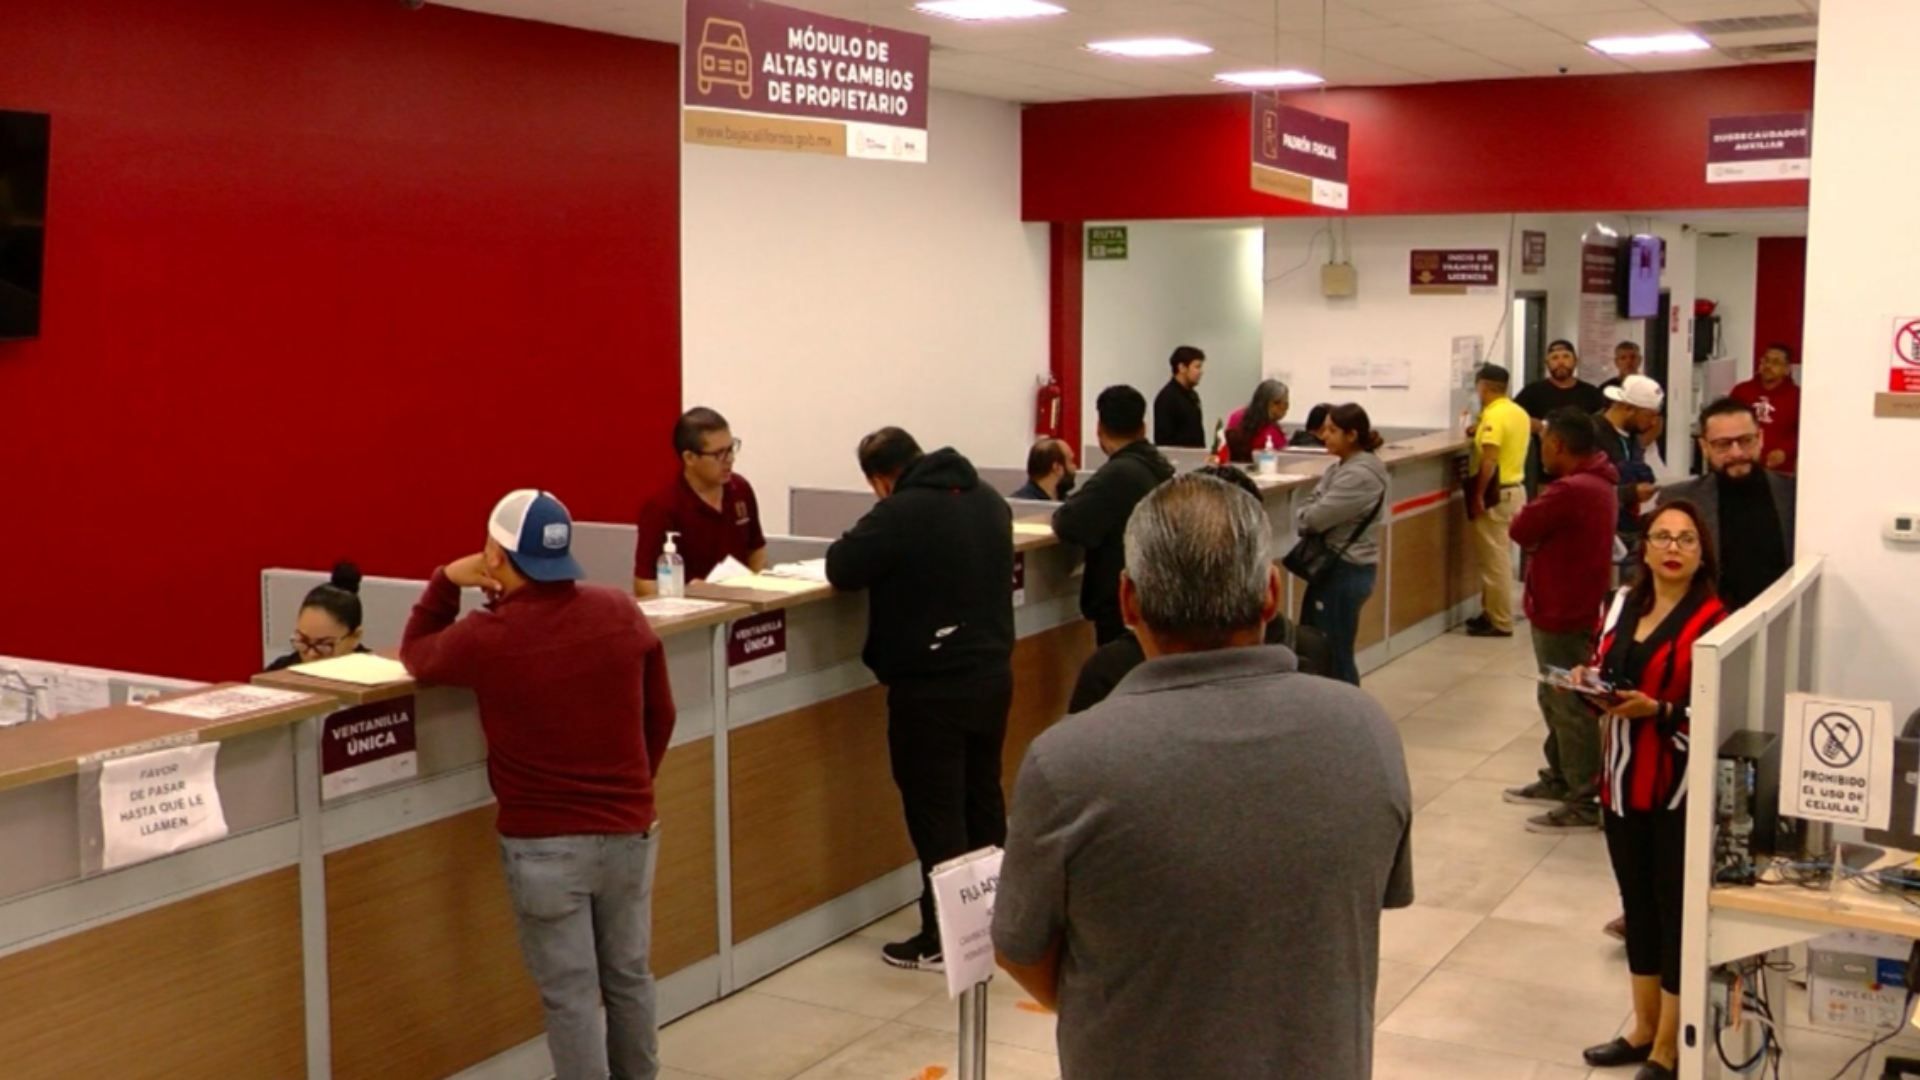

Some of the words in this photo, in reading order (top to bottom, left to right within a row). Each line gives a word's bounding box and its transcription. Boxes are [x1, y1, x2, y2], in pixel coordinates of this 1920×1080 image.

[788, 26, 862, 58] MÓDULO
[866, 40, 889, 62] DE
[762, 52, 817, 78] ALTAS
[821, 59, 833, 80] Y
[835, 62, 914, 92] CAMBIOS
[768, 81, 792, 103] DE
[796, 84, 908, 116] PROPIETARIO
[1312, 141, 1337, 160] FISCAL
[1734, 140, 1784, 151] AUXILIAR
[1477, 253, 1489, 261] DE
[1447, 273, 1488, 281] LICENCIA
[332, 711, 409, 741] VENTANILLA
[347, 731, 396, 756] ÚNICA
[140, 763, 179, 781] FAVOR
[1803, 770, 1866, 788] PROHIBIDO
[129, 788, 145, 802] DE
[148, 781, 185, 799] PASAR
[1803, 785, 1815, 795] EL
[1820, 788, 1844, 799] USO
[1848, 791, 1864, 801] DE
[120, 806, 156, 823] HASTA
[160, 799, 185, 814] QUE
[189, 794, 204, 807] LE
[1805, 799, 1859, 814] CELULAR
[140, 816, 189, 837] LLAMEN
